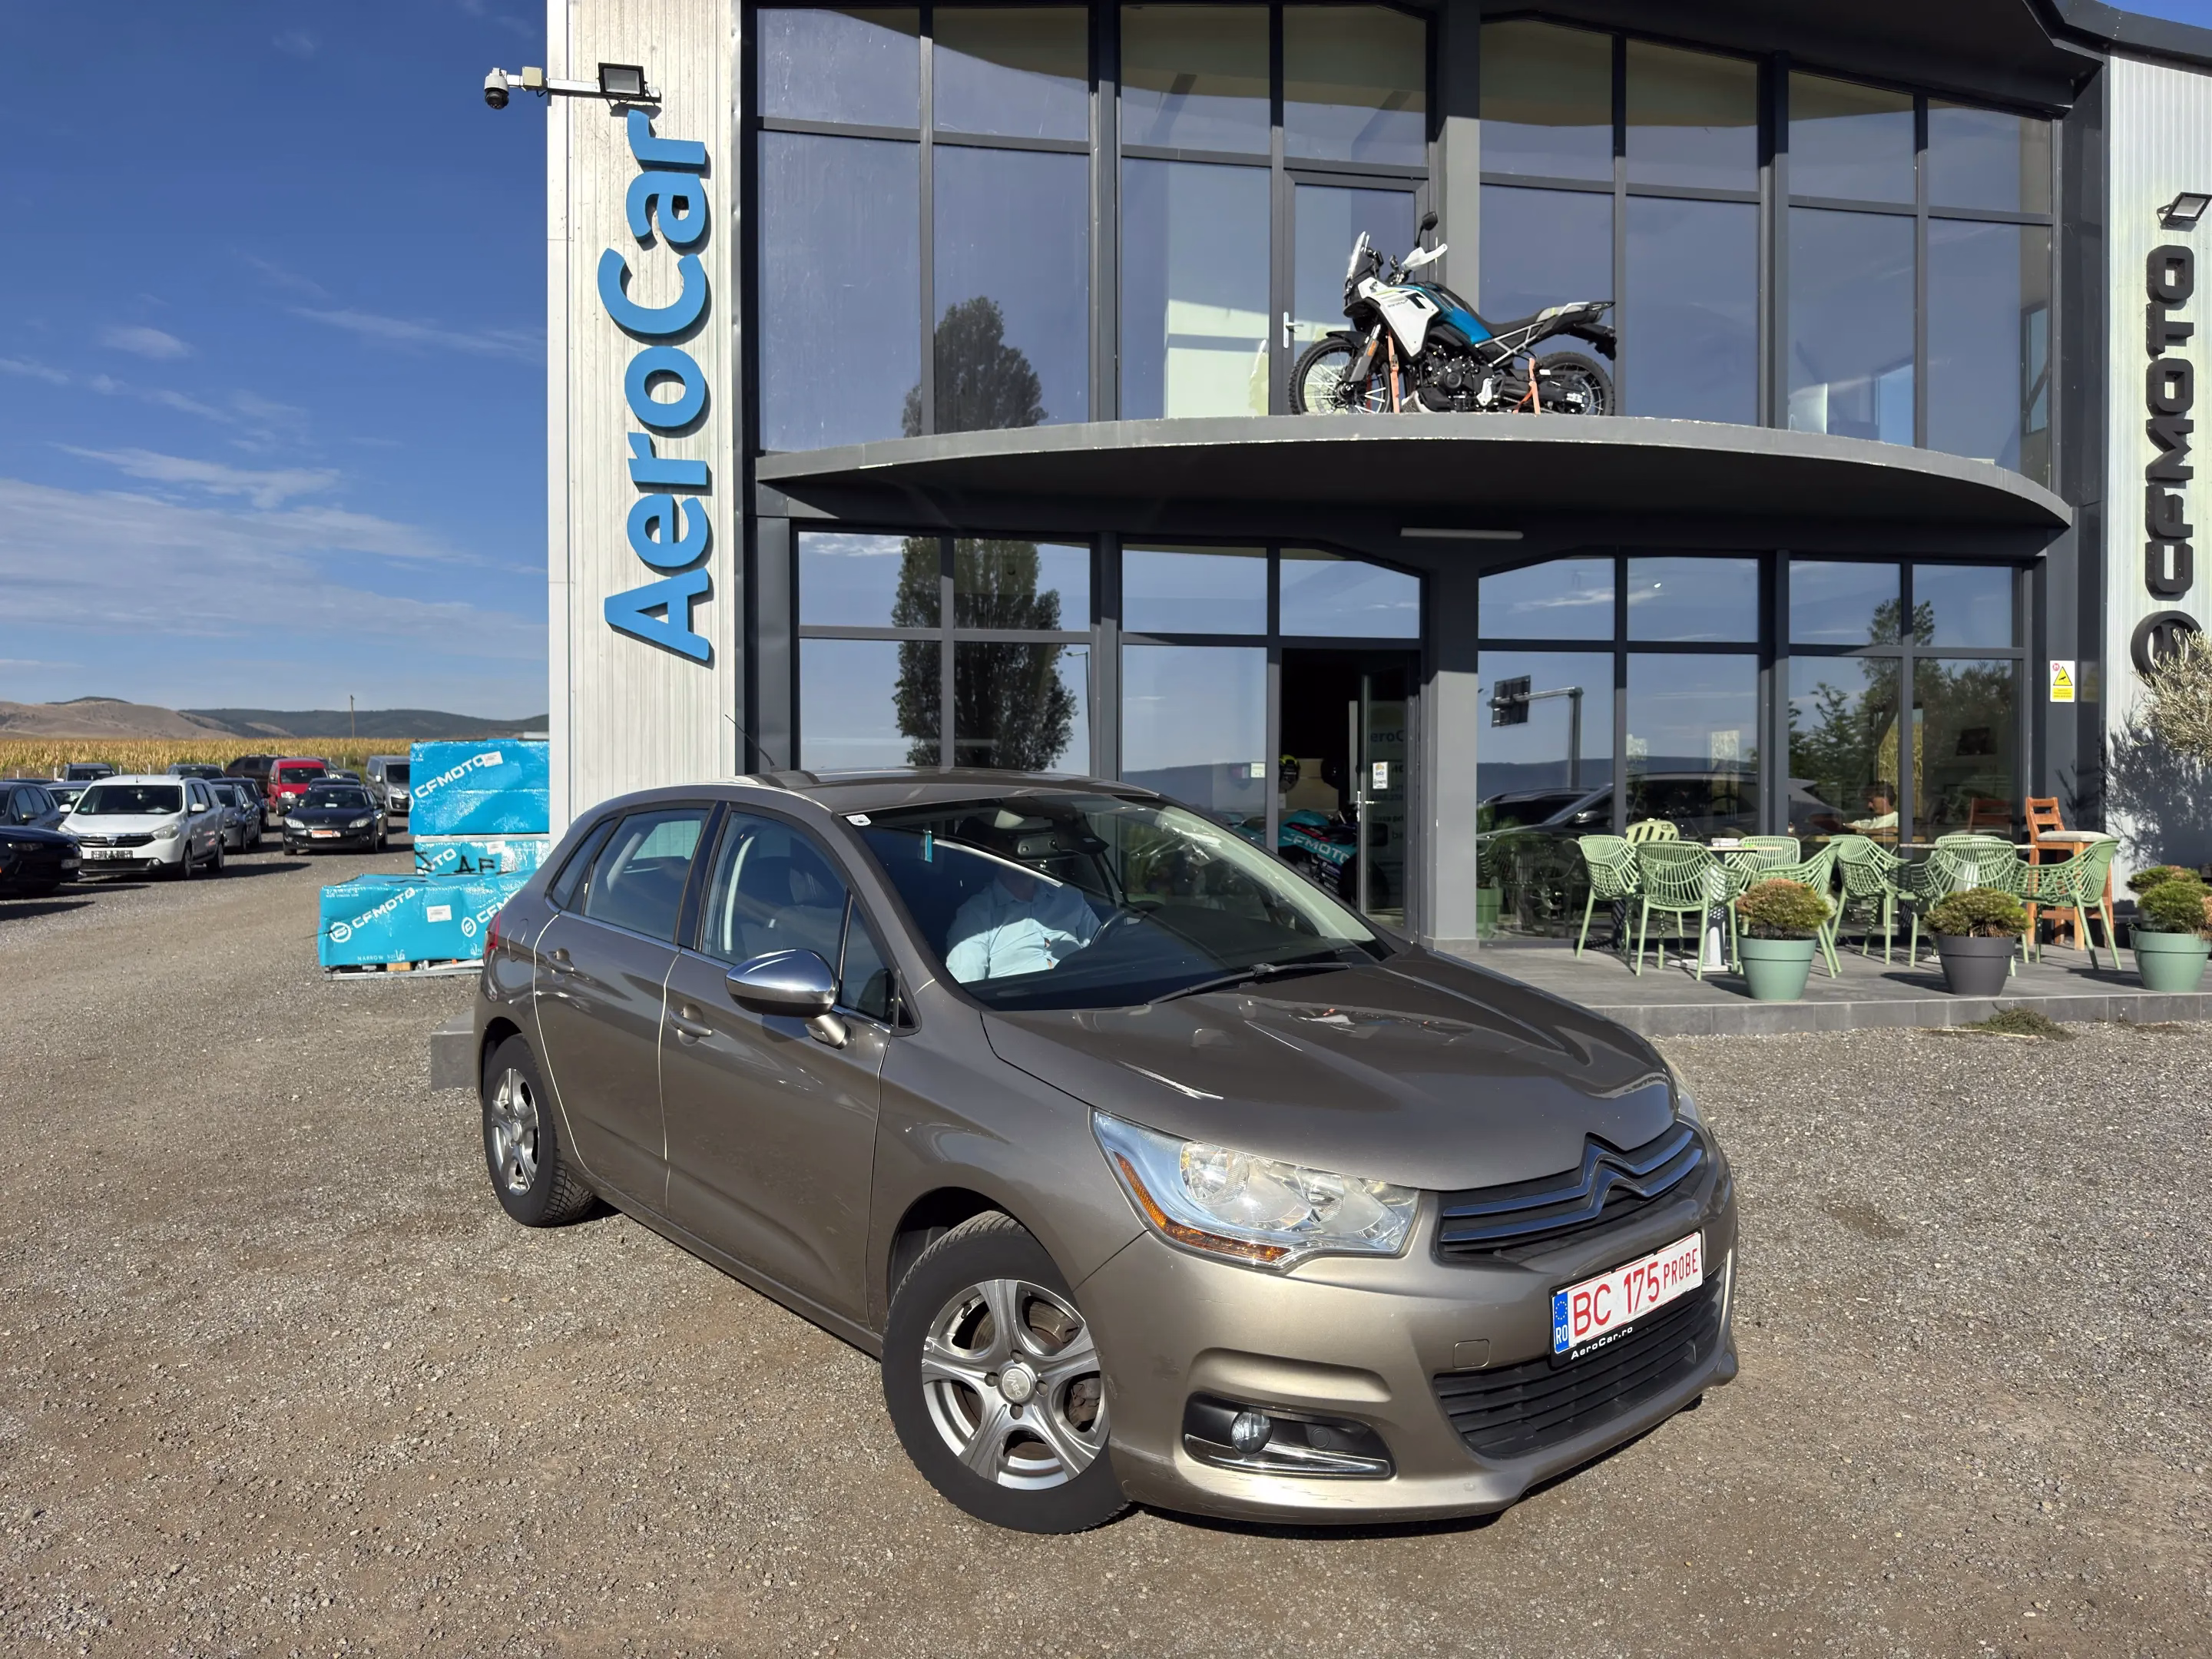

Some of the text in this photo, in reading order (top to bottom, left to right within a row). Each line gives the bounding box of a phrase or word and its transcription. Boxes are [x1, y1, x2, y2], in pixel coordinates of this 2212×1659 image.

[598, 109, 712, 665] AeroCar
[2145, 244, 2195, 598] CFMOTO
[1370, 730, 1404, 743] eroC
[415, 753, 485, 799] CFMOTO
[352, 887, 416, 929] CFMOTO
[476, 890, 519, 924] CFM
[1573, 1248, 1698, 1338] BC 175 PROBE
[1555, 1324, 1568, 1345] RO
[1571, 1326, 1633, 1360] AeroCar.ro
